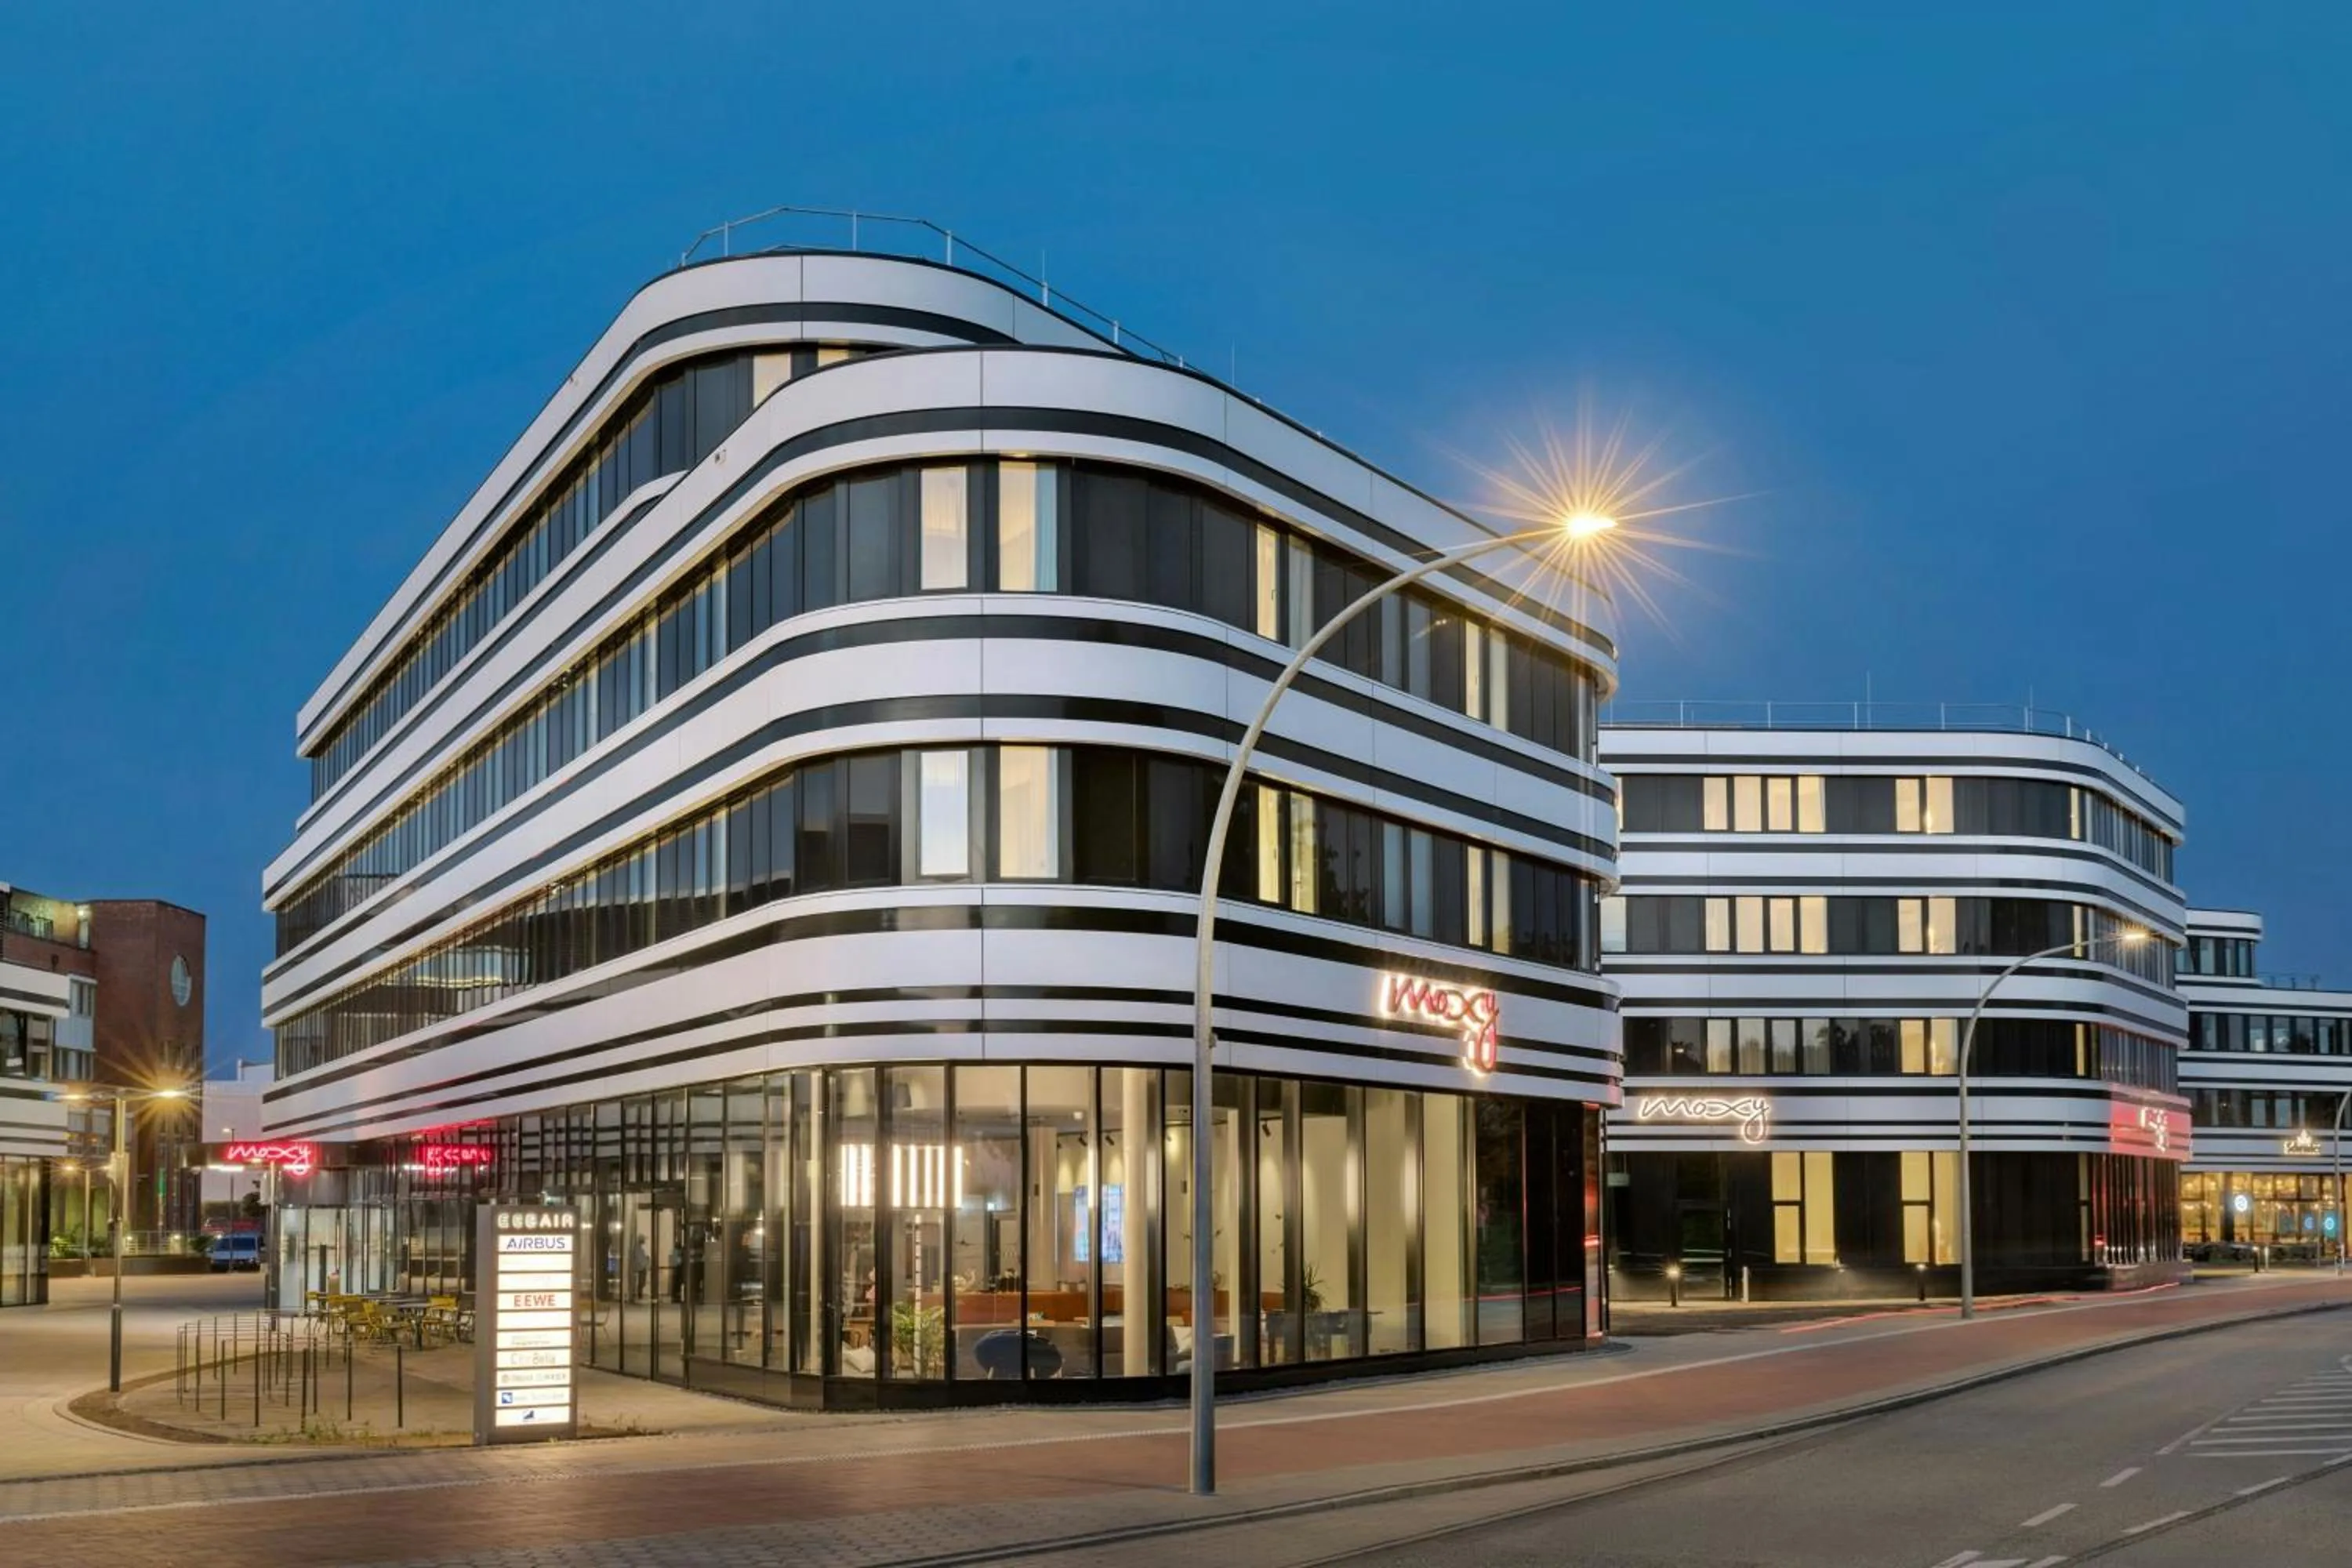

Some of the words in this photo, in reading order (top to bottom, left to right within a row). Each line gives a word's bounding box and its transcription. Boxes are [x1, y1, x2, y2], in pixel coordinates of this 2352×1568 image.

[1640, 1096, 1769, 1144] moxy
[227, 1145, 311, 1175] moxy
[506, 1237, 566, 1249] AIRBUS
